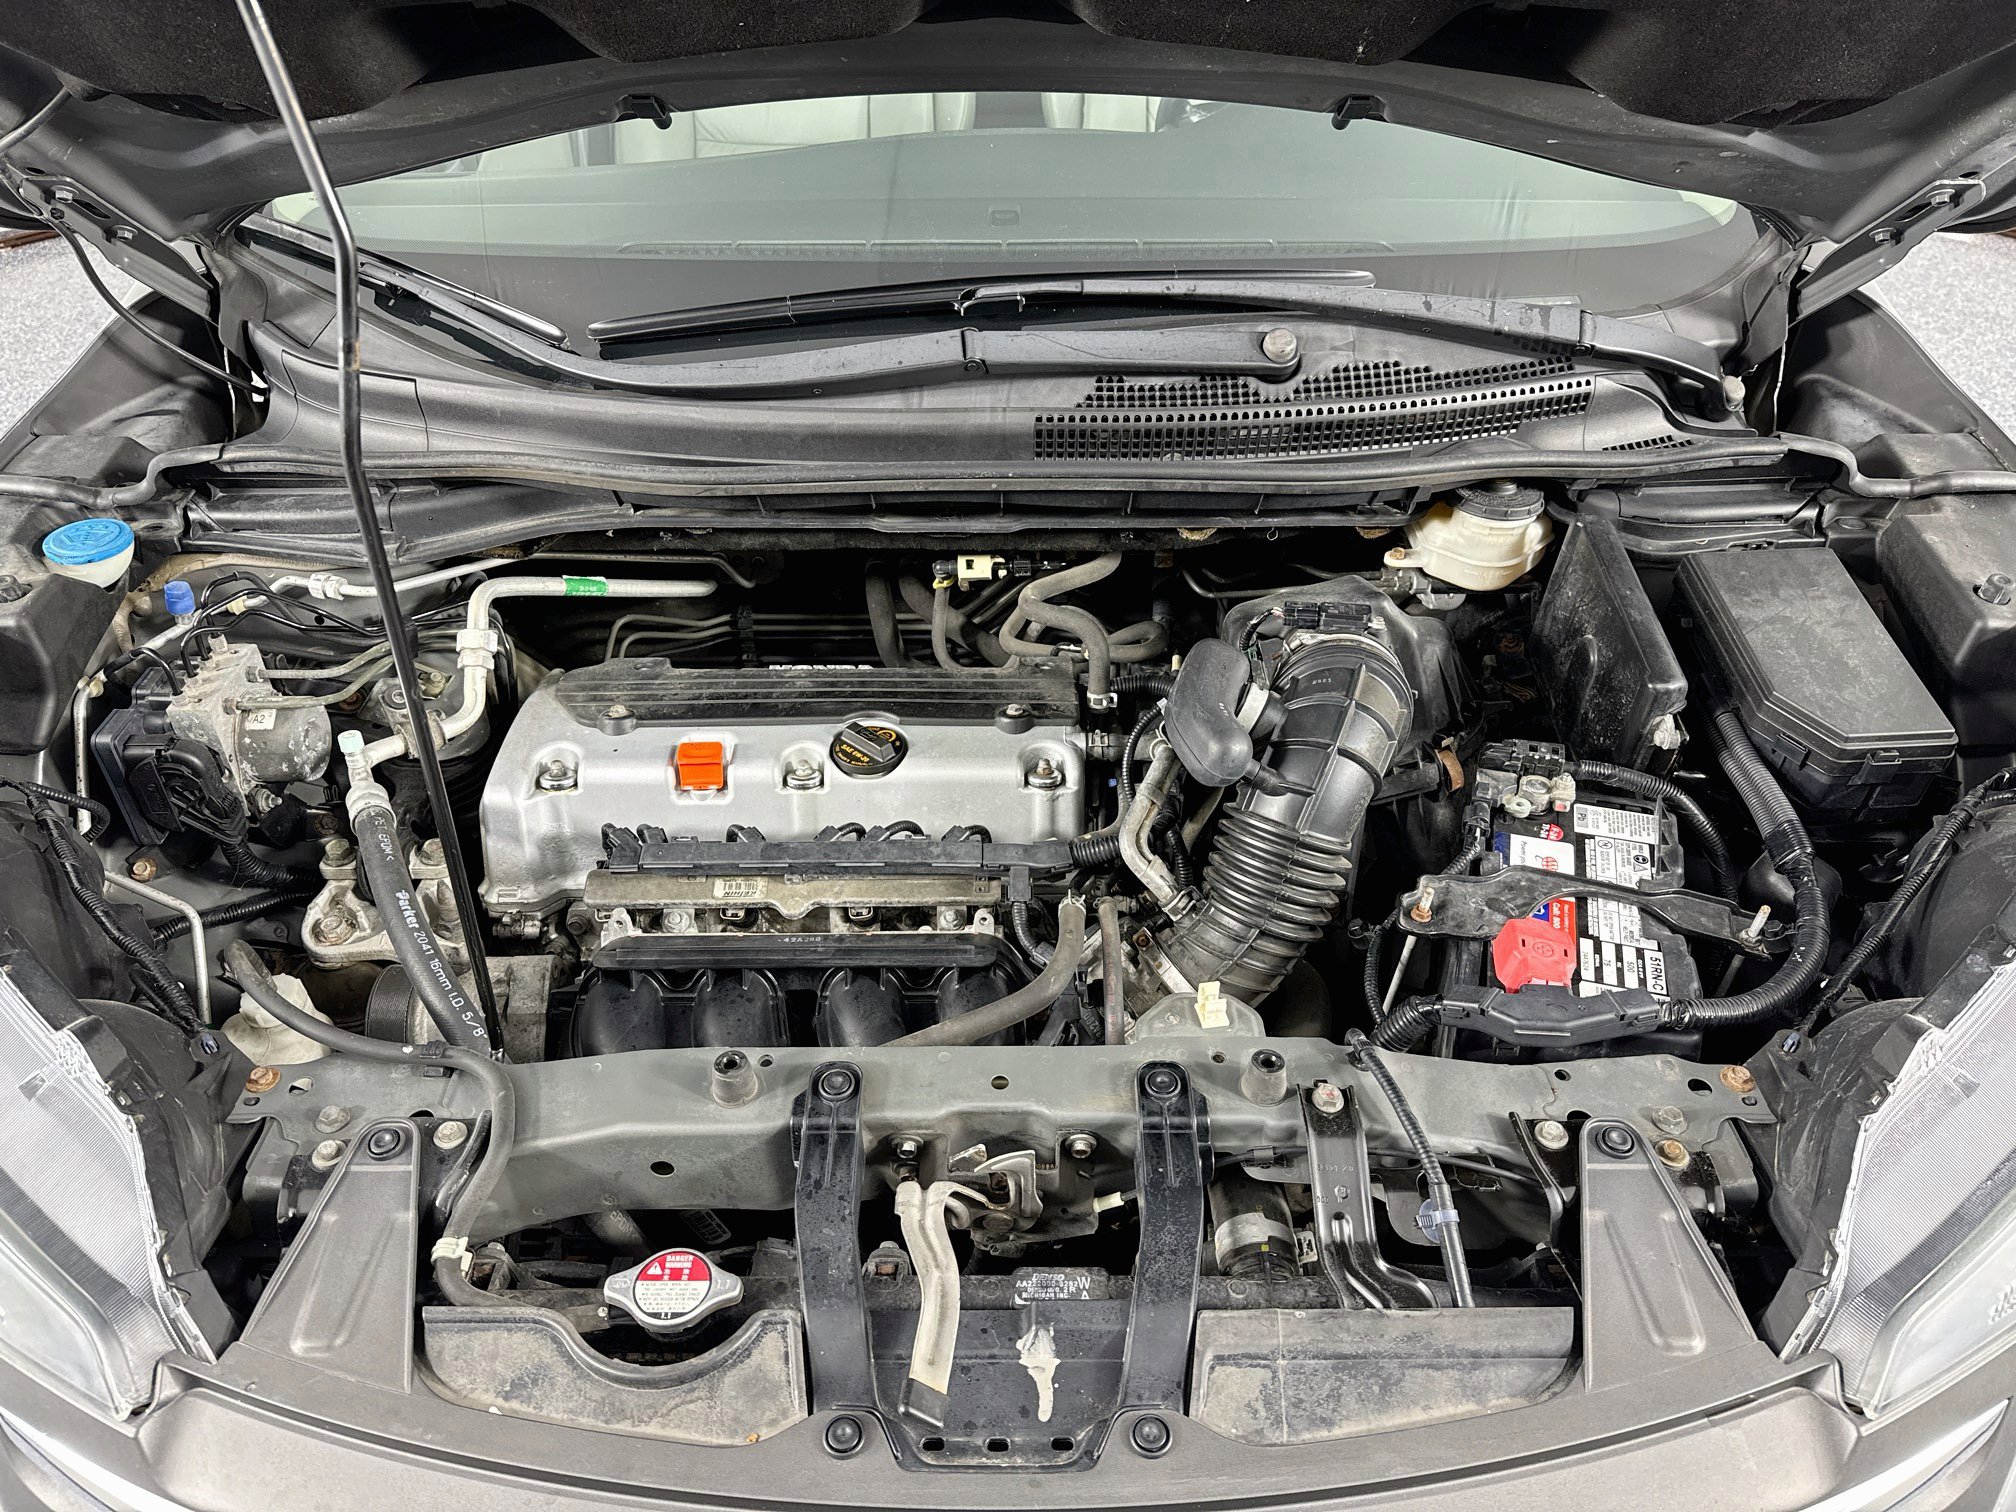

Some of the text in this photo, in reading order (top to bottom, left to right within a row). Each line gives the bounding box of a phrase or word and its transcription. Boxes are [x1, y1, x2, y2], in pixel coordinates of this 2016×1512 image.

[1578, 812, 1586, 822] Pb
[395, 890, 420, 929] Parker
[414, 930, 434, 956] 2041
[430, 958, 452, 992] 16mm
[448, 986, 465, 1011] I.D.
[1626, 961, 1635, 973] 500
[1650, 956, 1664, 991] 51RN-C
